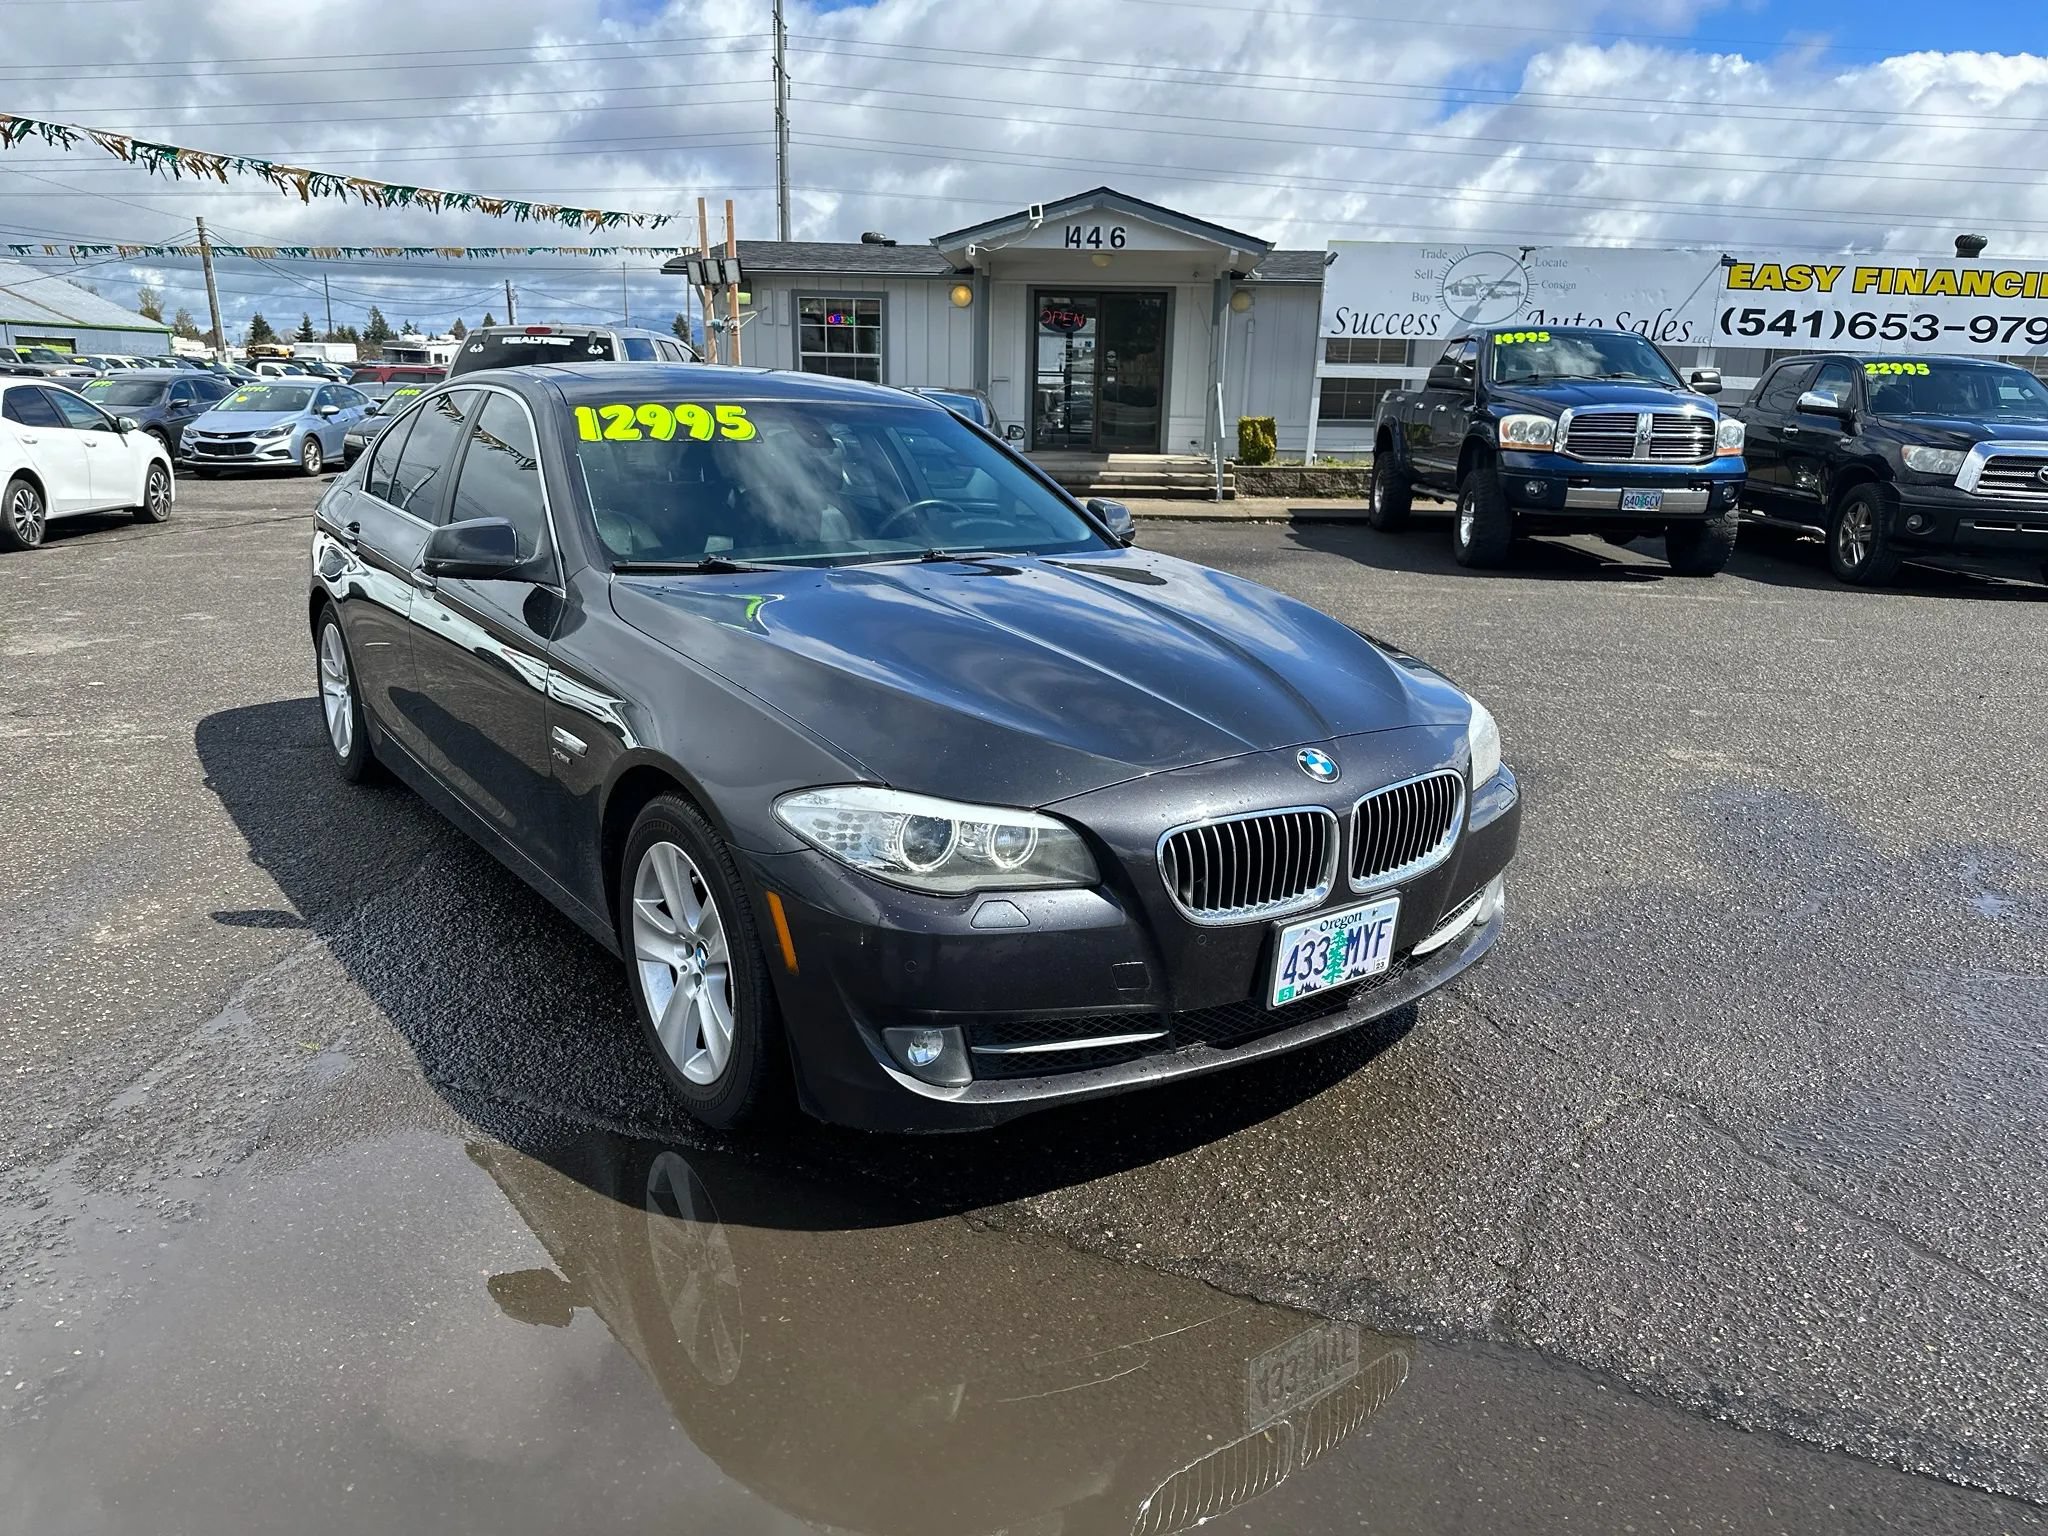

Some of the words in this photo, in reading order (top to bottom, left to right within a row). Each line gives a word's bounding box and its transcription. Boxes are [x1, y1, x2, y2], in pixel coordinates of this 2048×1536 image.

[1065, 225, 1126, 249] 1446
[1420, 249, 1448, 259] Trade
[1534, 257, 1568, 268] Locate
[1414, 269, 1434, 280] Sell
[1727, 262, 1845, 292] EASY
[1851, 266, 2048, 299] FINANCI
[1541, 280, 1576, 290] Consign
[1411, 292, 1433, 305] Buy
[1040, 310, 1085, 327] OPEN
[1331, 306, 1441, 336] Success
[1616, 308, 1694, 343] Sales
[1863, 363, 1931, 376] 22995
[574, 402, 757, 441] 12995
[1319, 912, 1362, 932] Oregon
[1282, 935, 1331, 985] 433
[1343, 917, 1393, 968] MYF
[1375, 961, 1385, 970] 23
[1282, 990, 1290, 999] 5
